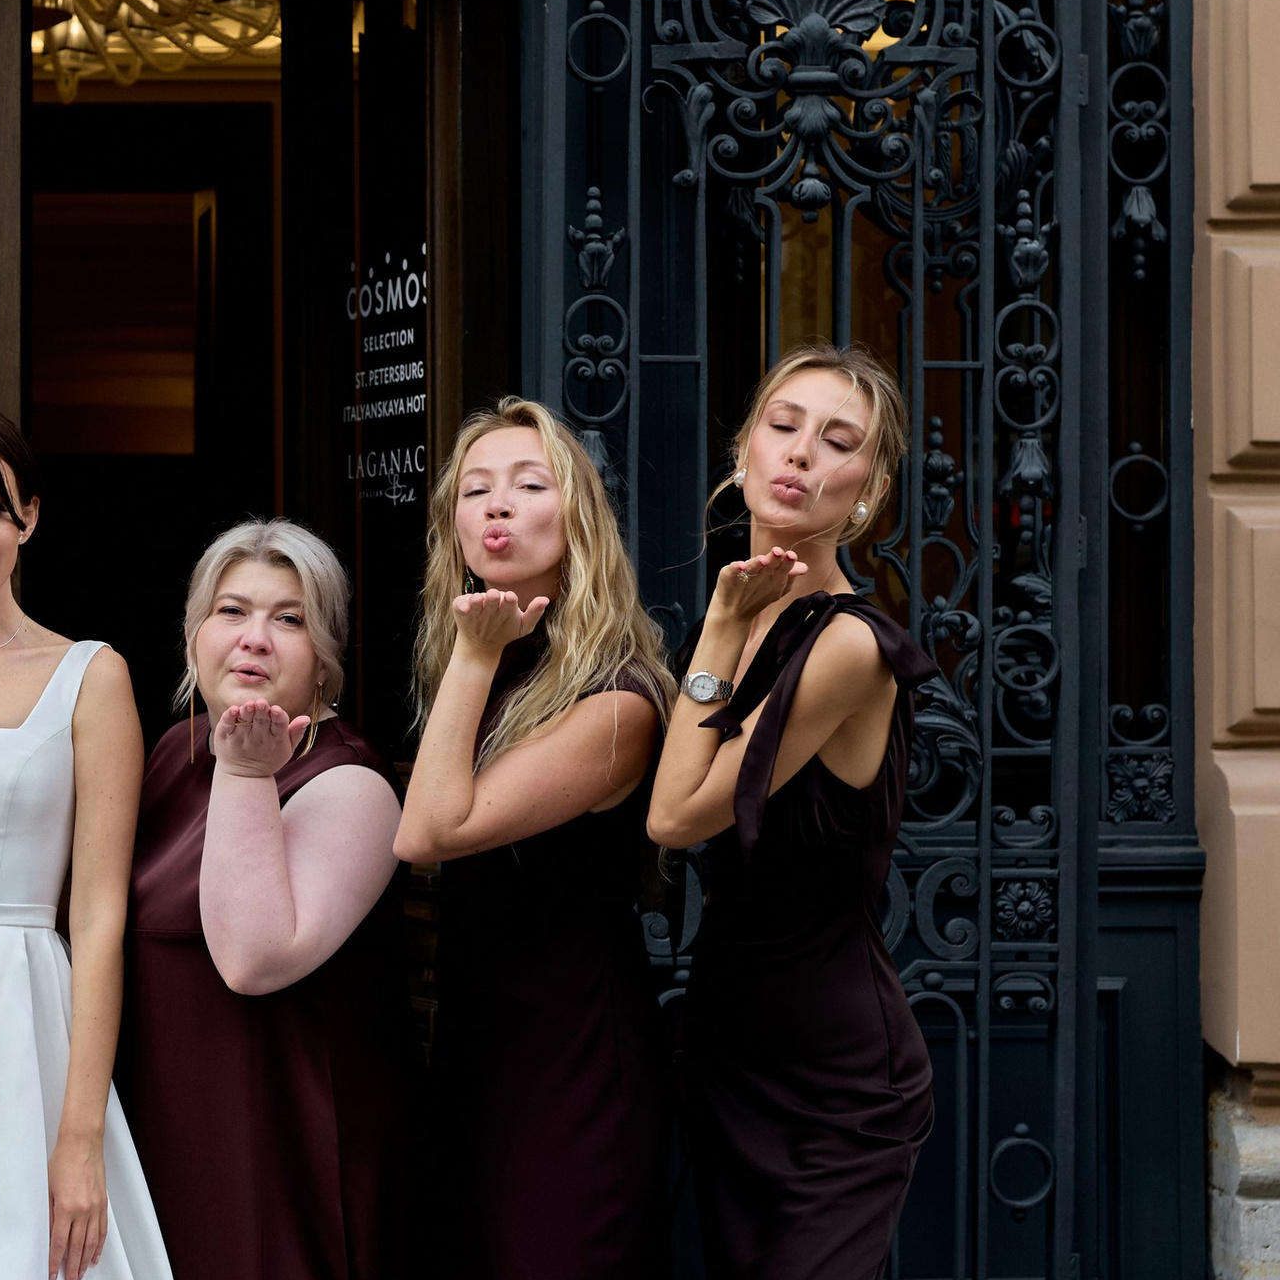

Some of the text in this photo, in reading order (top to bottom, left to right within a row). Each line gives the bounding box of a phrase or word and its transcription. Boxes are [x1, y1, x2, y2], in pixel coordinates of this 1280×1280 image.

[363, 327, 415, 353] SELECTION
[355, 360, 425, 389] ST. PETERSBURG
[342, 397, 406, 424] ITALYANSKAYA
